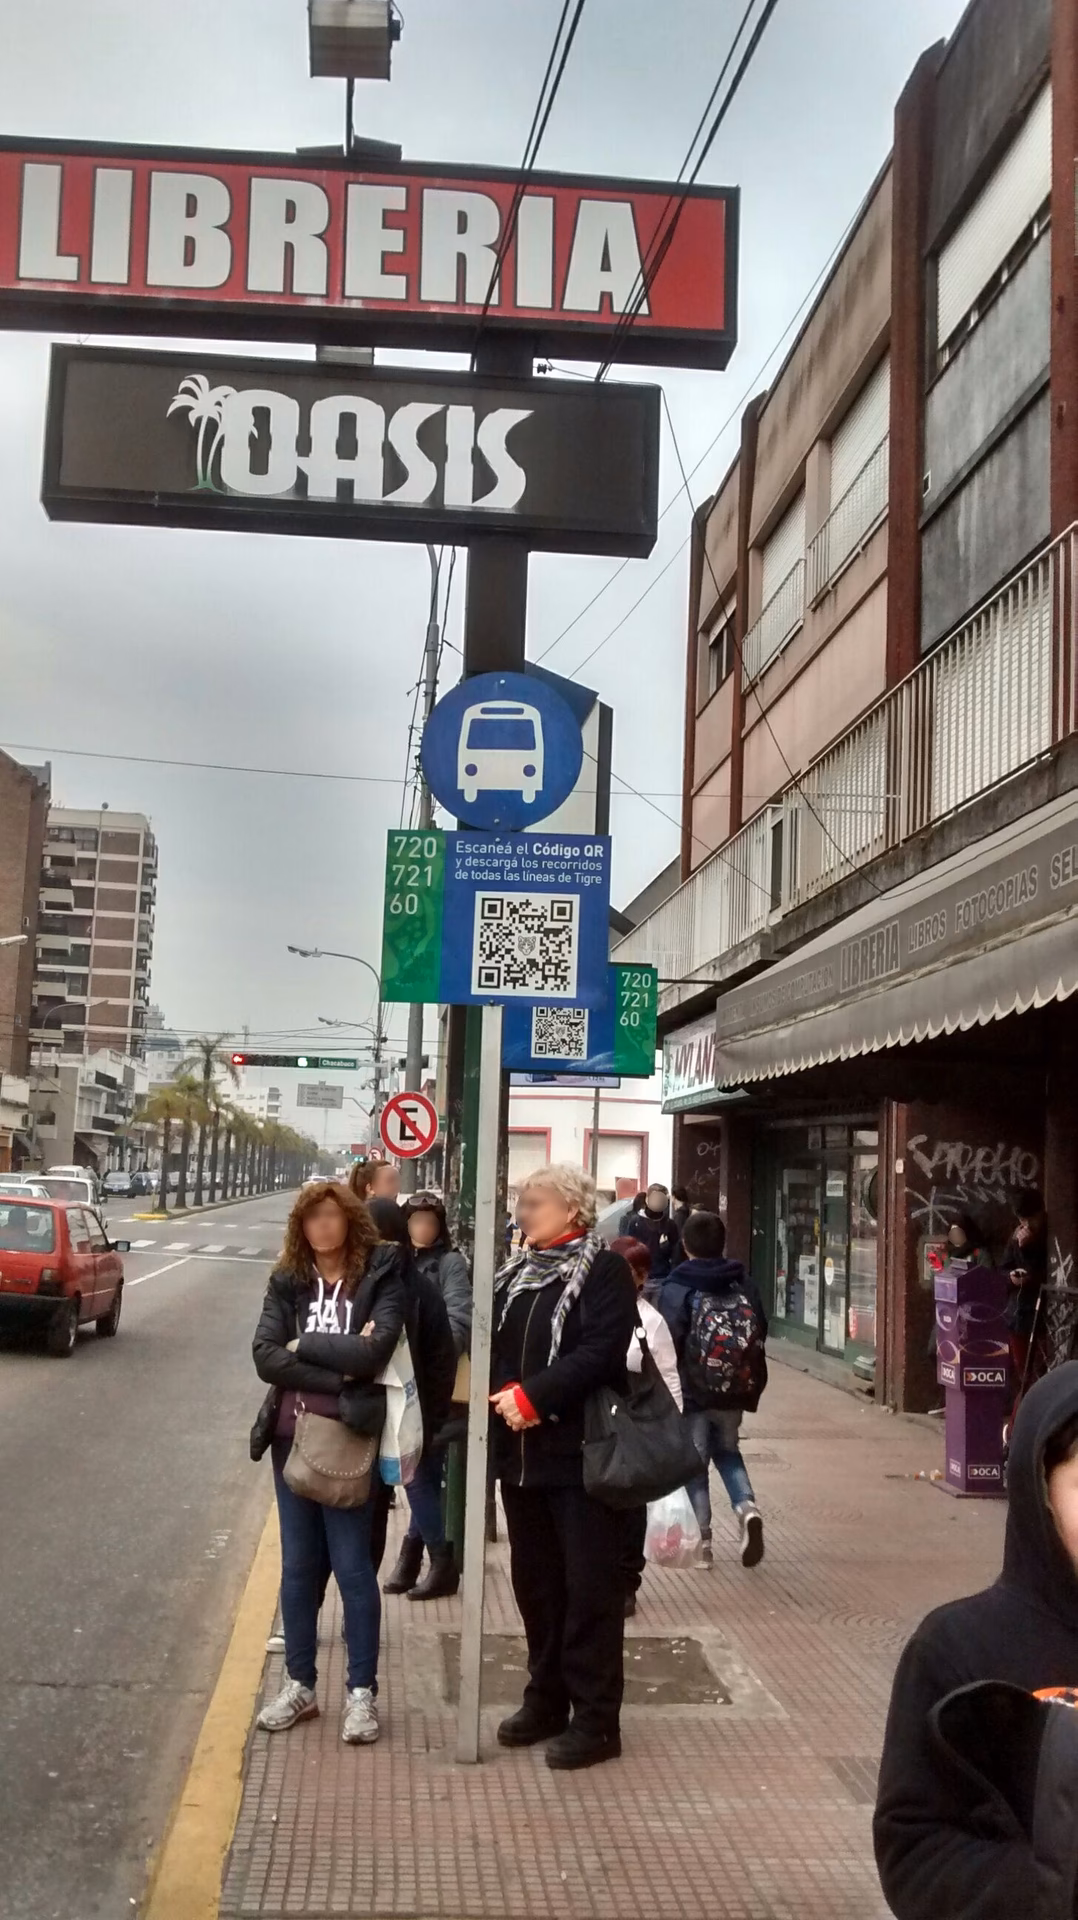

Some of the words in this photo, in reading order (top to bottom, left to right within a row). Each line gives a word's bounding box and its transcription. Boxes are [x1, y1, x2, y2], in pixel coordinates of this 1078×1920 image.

[19, 162, 651, 315] LIBRERIA
[221, 389, 534, 508] OASIS
[394, 836, 437, 858] 720
[456, 841, 512, 854] Escaneá
[516, 842, 528, 855] el
[533, 842, 580, 859] Código
[584, 844, 603, 858] QR
[455, 858, 463, 868] y
[465, 856, 518, 871] descargá
[521, 858, 538, 869] los
[542, 859, 602, 871] recorridos
[392, 864, 432, 887] 721
[455, 869, 468, 880] de
[471, 869, 501, 880] todas
[504, 870, 520, 881] las
[523, 870, 555, 882] líneas
[558, 872, 571, 883] de
[574, 872, 602, 887] Tigre
[390, 893, 418, 915] 60
[840, 920, 900, 994] LIBRERIA
[908, 909, 947, 954] LIBROS
[955, 865, 1038, 934] FOTOCOPIAS
[622, 972, 652, 988] 720
[621, 991, 648, 1008] 721
[620, 1011, 640, 1026] 60
[977, 1371, 1003, 1382] OCA
[978, 1467, 998, 1476] OCA
